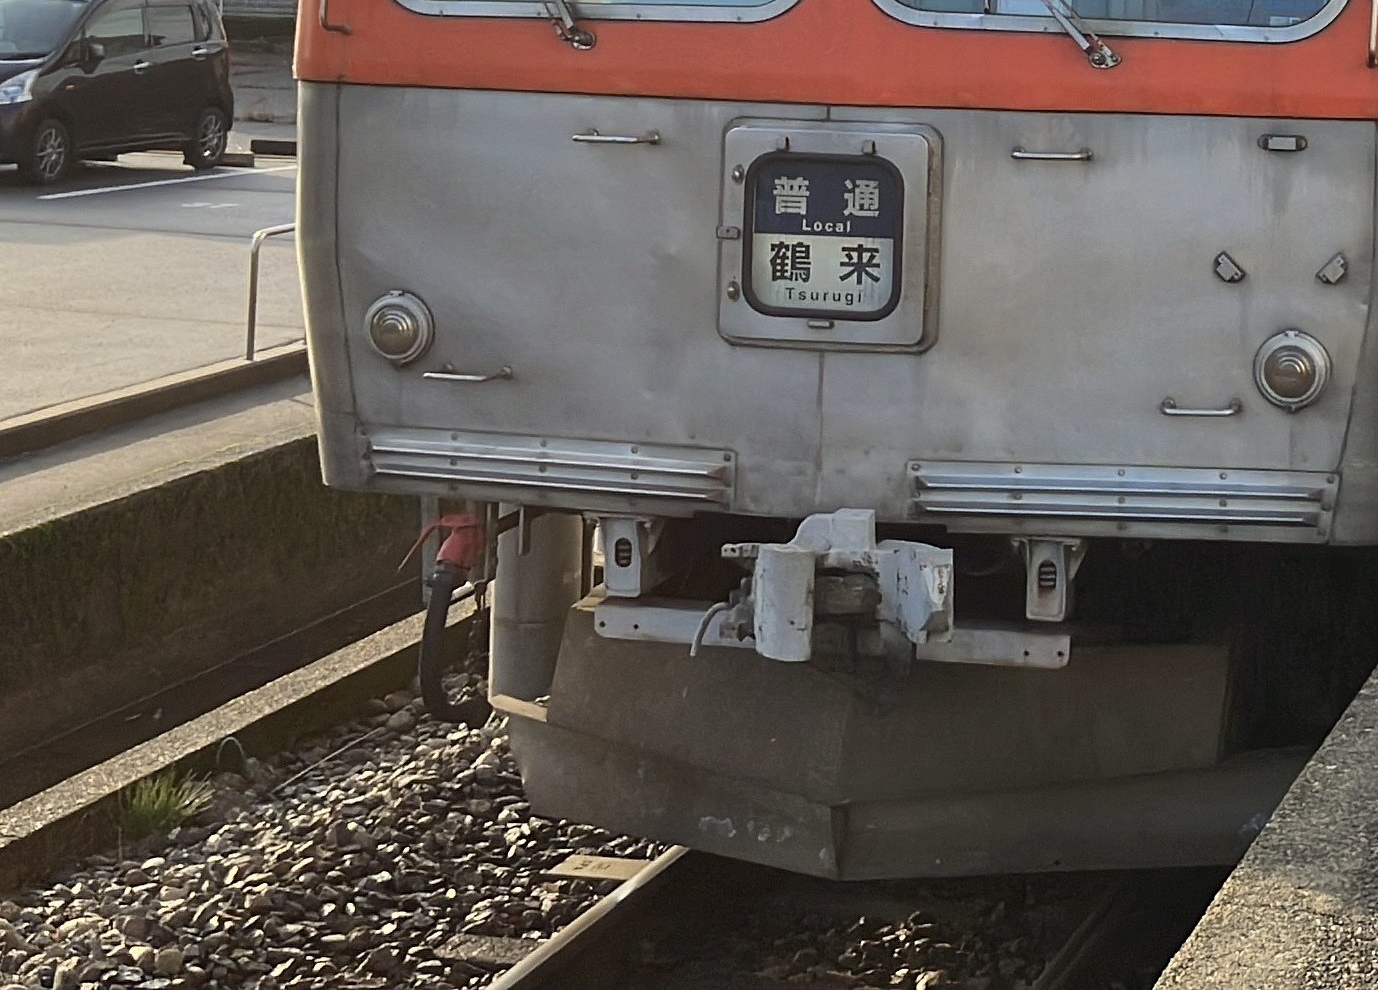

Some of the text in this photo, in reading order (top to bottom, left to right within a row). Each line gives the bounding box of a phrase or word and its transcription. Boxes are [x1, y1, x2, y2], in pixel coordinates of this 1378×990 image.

[773, 176, 880, 218] 普通
[801, 218, 851, 233] Local
[769, 241, 881, 286] 鶴来
[785, 287, 864, 306] Tsurugi
